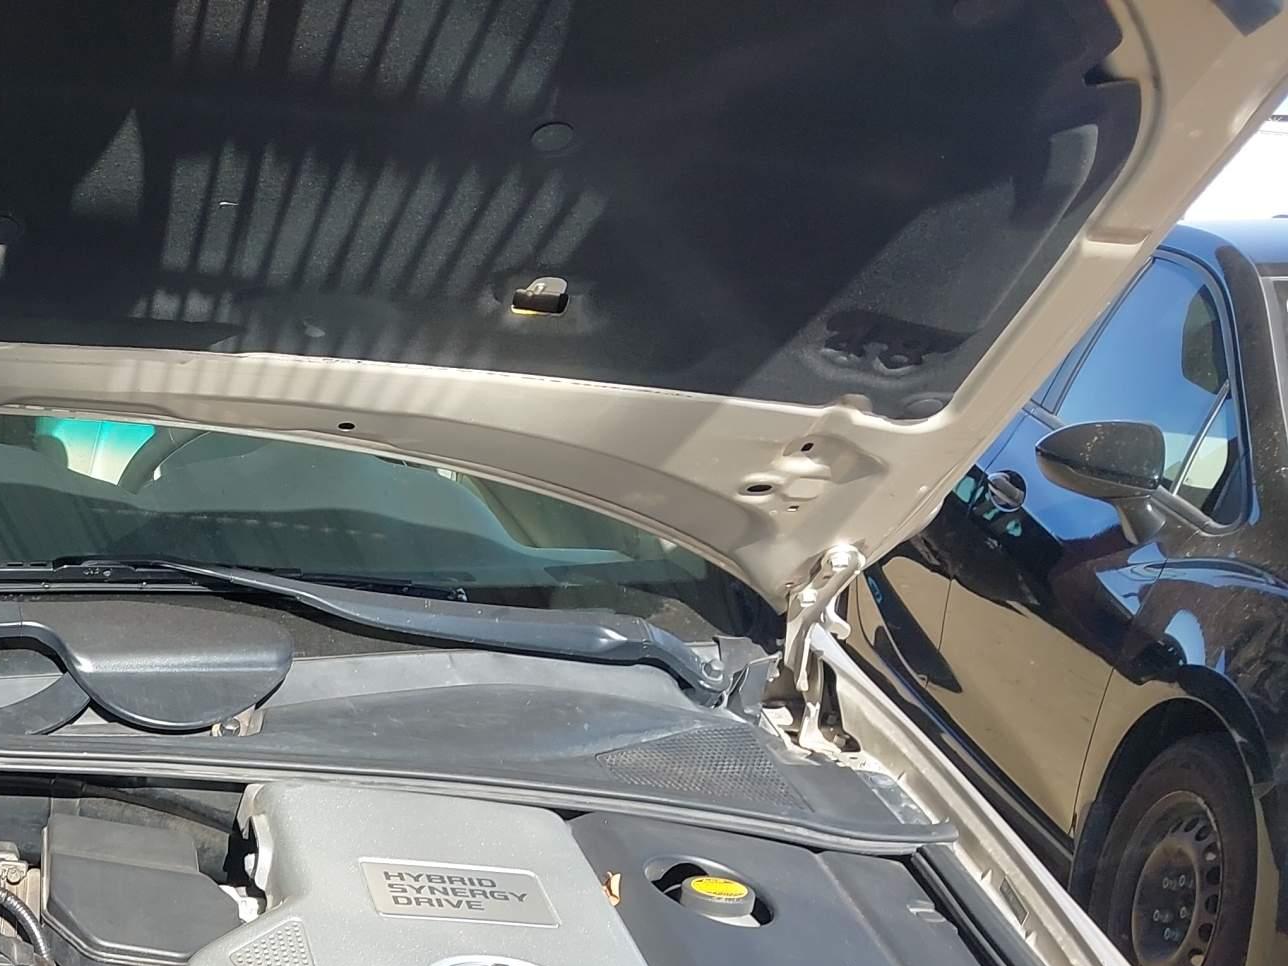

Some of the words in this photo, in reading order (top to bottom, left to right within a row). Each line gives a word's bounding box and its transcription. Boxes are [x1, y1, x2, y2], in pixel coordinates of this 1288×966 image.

[383, 871, 497, 888] HYBRID
[387, 883, 528, 902] SYNERGY
[391, 895, 485, 911] DRIVE
